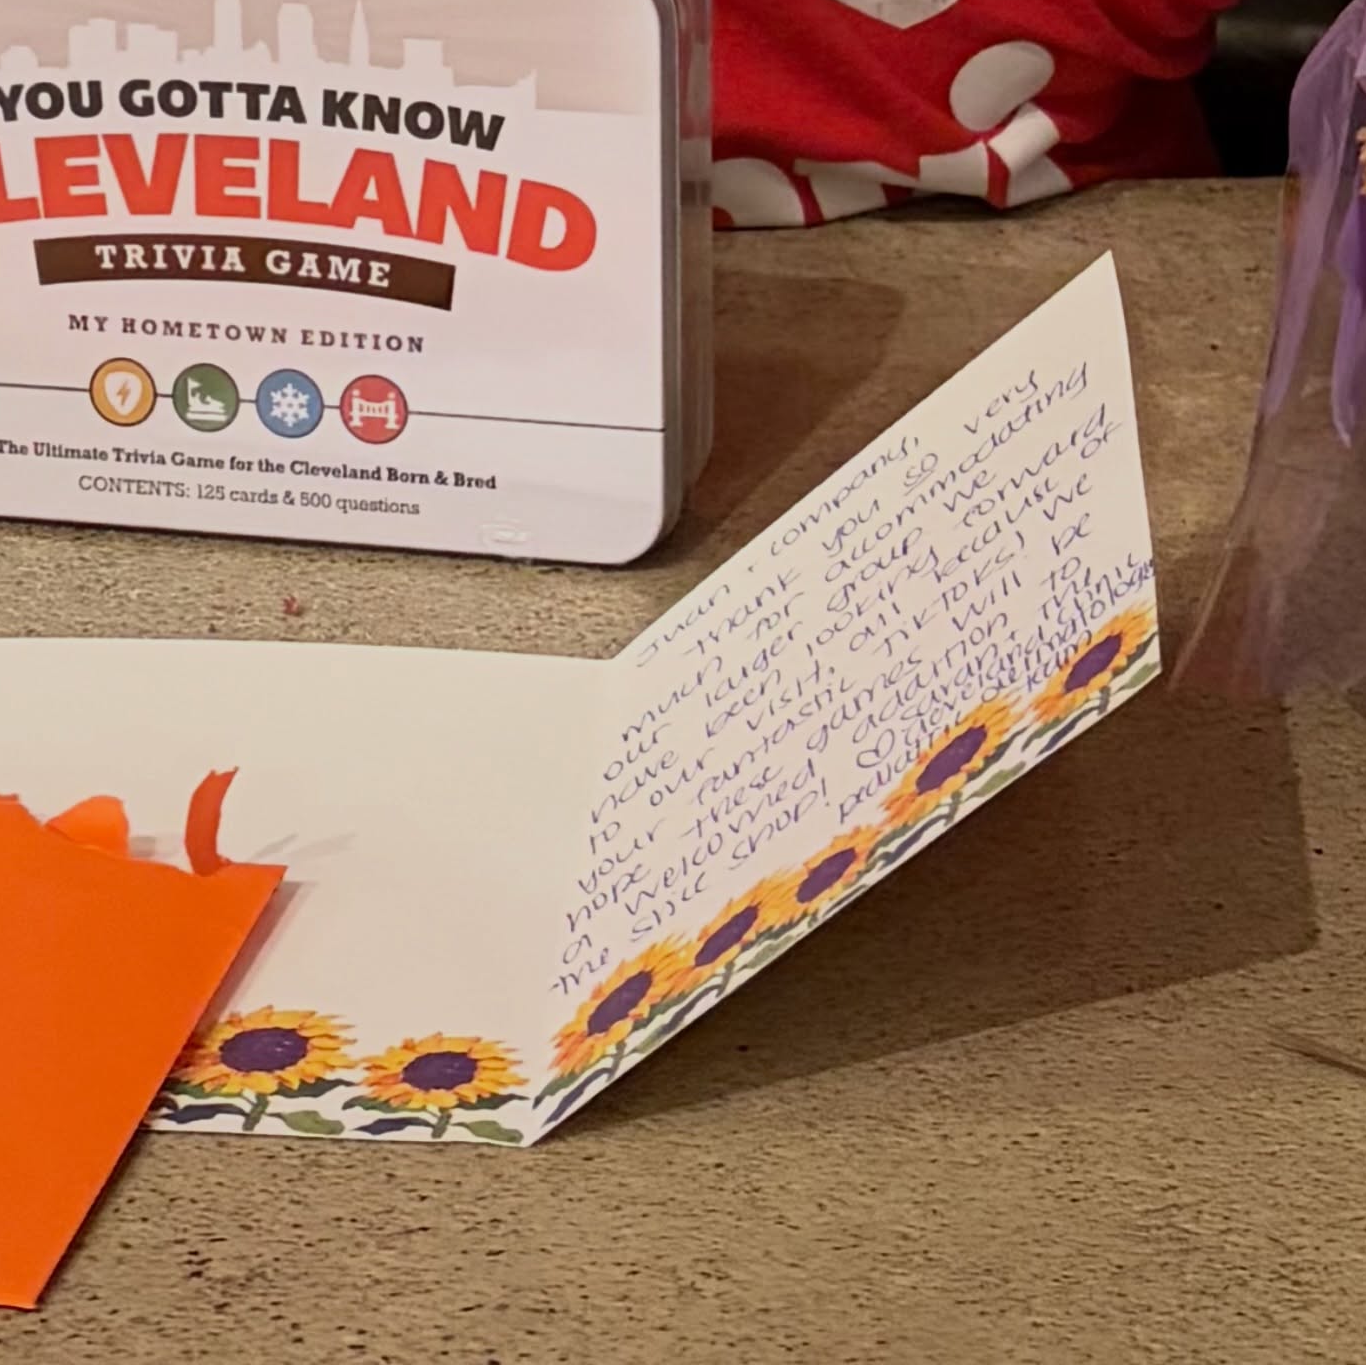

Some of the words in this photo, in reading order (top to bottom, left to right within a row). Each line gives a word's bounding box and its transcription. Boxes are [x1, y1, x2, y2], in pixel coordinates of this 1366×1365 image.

[119, 79, 307, 124] GOTTA
[322, 89, 506, 151] KNOW
[95, 244, 246, 272] TRIVIA
[265, 250, 391, 287] GAME
[68, 314, 110, 333] MY
[121, 317, 289, 345] HOMETOWN
[301, 329, 425, 353] EDITION
[33, 442, 109, 461] Ultimate
[112, 448, 167, 466] Trivia
[170, 452, 225, 470] Game
[229, 456, 254, 472] for
[258, 458, 286, 474] the
[290, 460, 382, 482] Cleveland
[386, 467, 431, 485] Born
[434, 470, 449, 486] &
[453, 472, 497, 490] Bred
[78, 475, 191, 498] CONTENTS:
[197, 483, 226, 500] 125
[229, 488, 279, 505] cards
[282, 490, 296, 506] &
[300, 492, 332, 509] 500
[336, 497, 421, 515] questions
[636, 584, 730, 667] Juan
